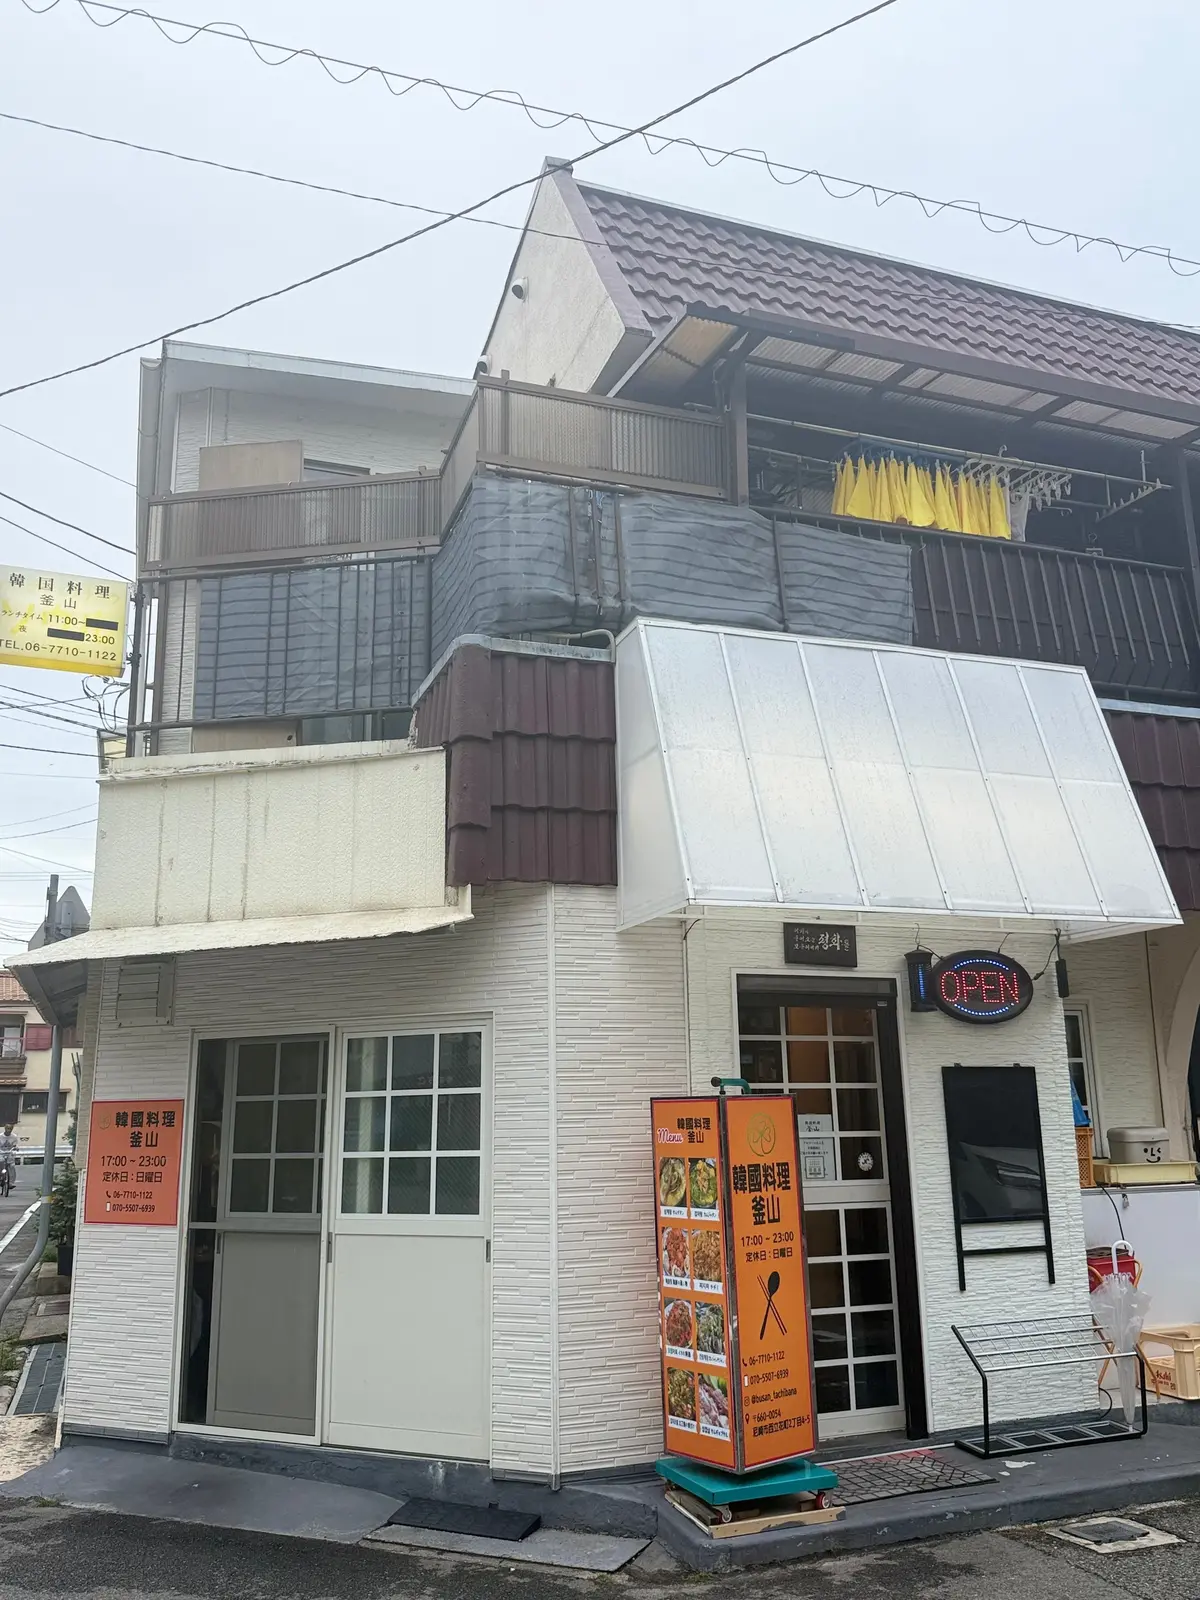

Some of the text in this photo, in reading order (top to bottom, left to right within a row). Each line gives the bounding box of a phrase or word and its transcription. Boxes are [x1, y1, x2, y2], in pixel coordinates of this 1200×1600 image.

[9, 572, 110, 599] 韓国料理
[40, 594, 77, 609] 釜山
[85, 633, 115, 645] 23:00
[941, 971, 1020, 1003] OPEN
[115, 1111, 175, 1128] 韓國料理
[677, 1117, 711, 1130] 韓國料理
[129, 1131, 158, 1148] 釜山
[657, 1128, 684, 1144] Menu
[687, 1130, 704, 1143] 釜山
[101, 1155, 127, 1167] 17:00
[138, 1155, 167, 1167] 23:00
[732, 1162, 791, 1194] 韓國料理
[113, 1190, 153, 1199] 06-7710-1122
[112, 1202, 155, 1213] 070-5507-6939
[751, 1194, 781, 1226] 釜山
[741, 1234, 763, 1247] 17:00
[772, 1231, 794, 1243] 23:00
[748, 1350, 785, 1366] 06-7710-1122
[750, 1368, 789, 1385] 070-5507-6939
[751, 1387, 797, 1404] @busan_tachibana
